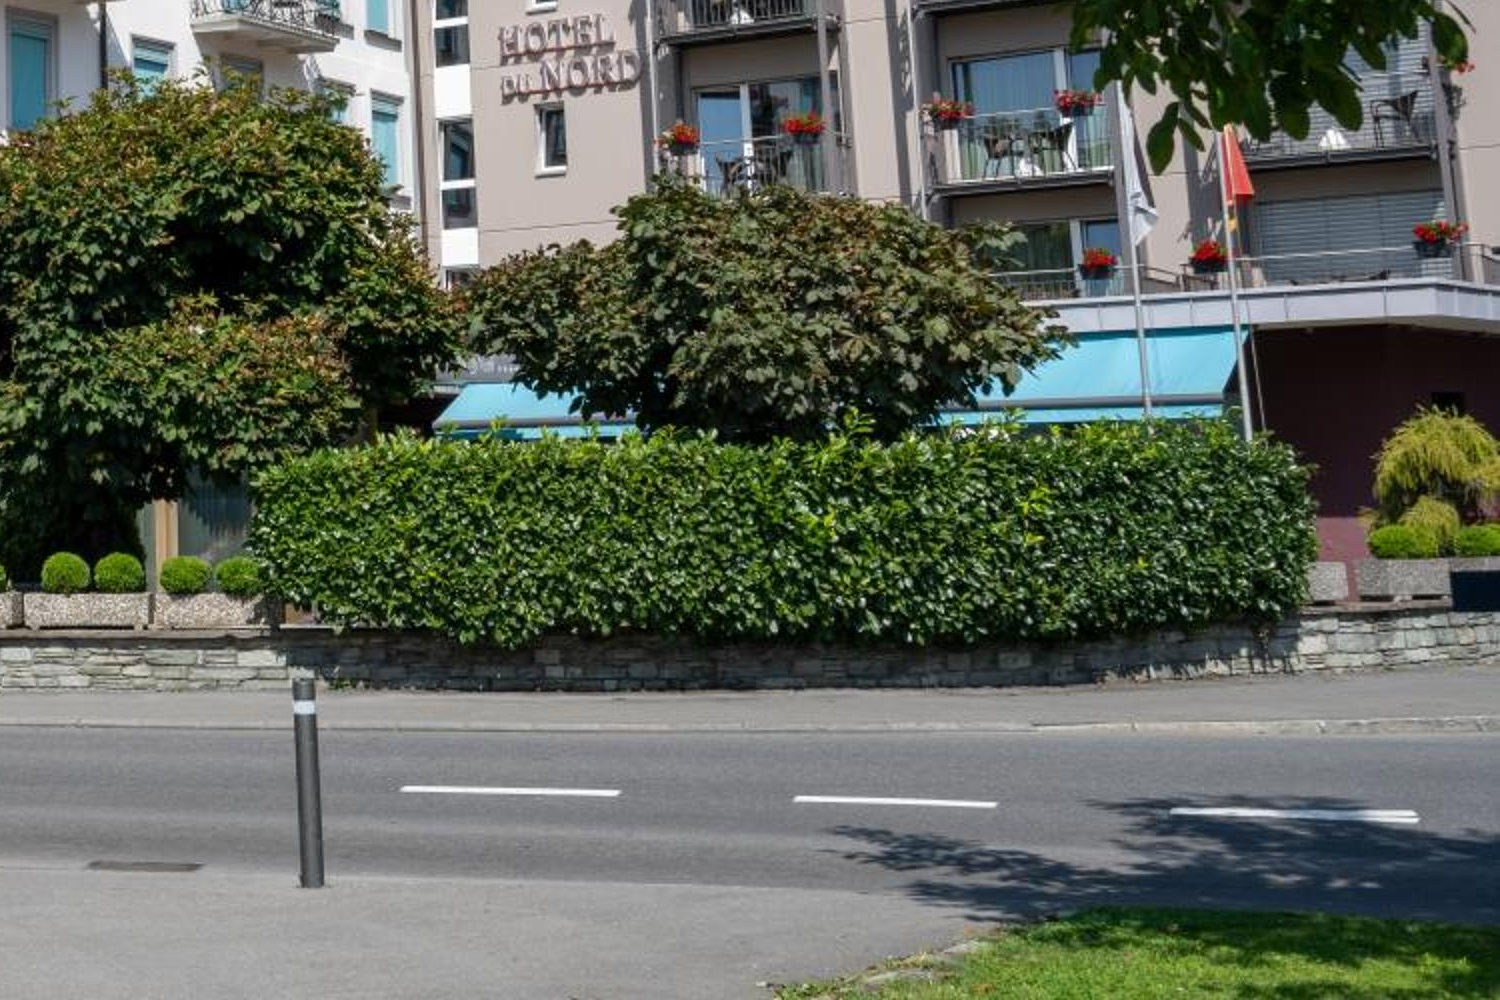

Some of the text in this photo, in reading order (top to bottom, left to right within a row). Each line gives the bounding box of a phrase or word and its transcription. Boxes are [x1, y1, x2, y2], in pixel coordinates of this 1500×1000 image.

[499, 13, 616, 58] HOTEL
[502, 50, 640, 97] DU NORD
